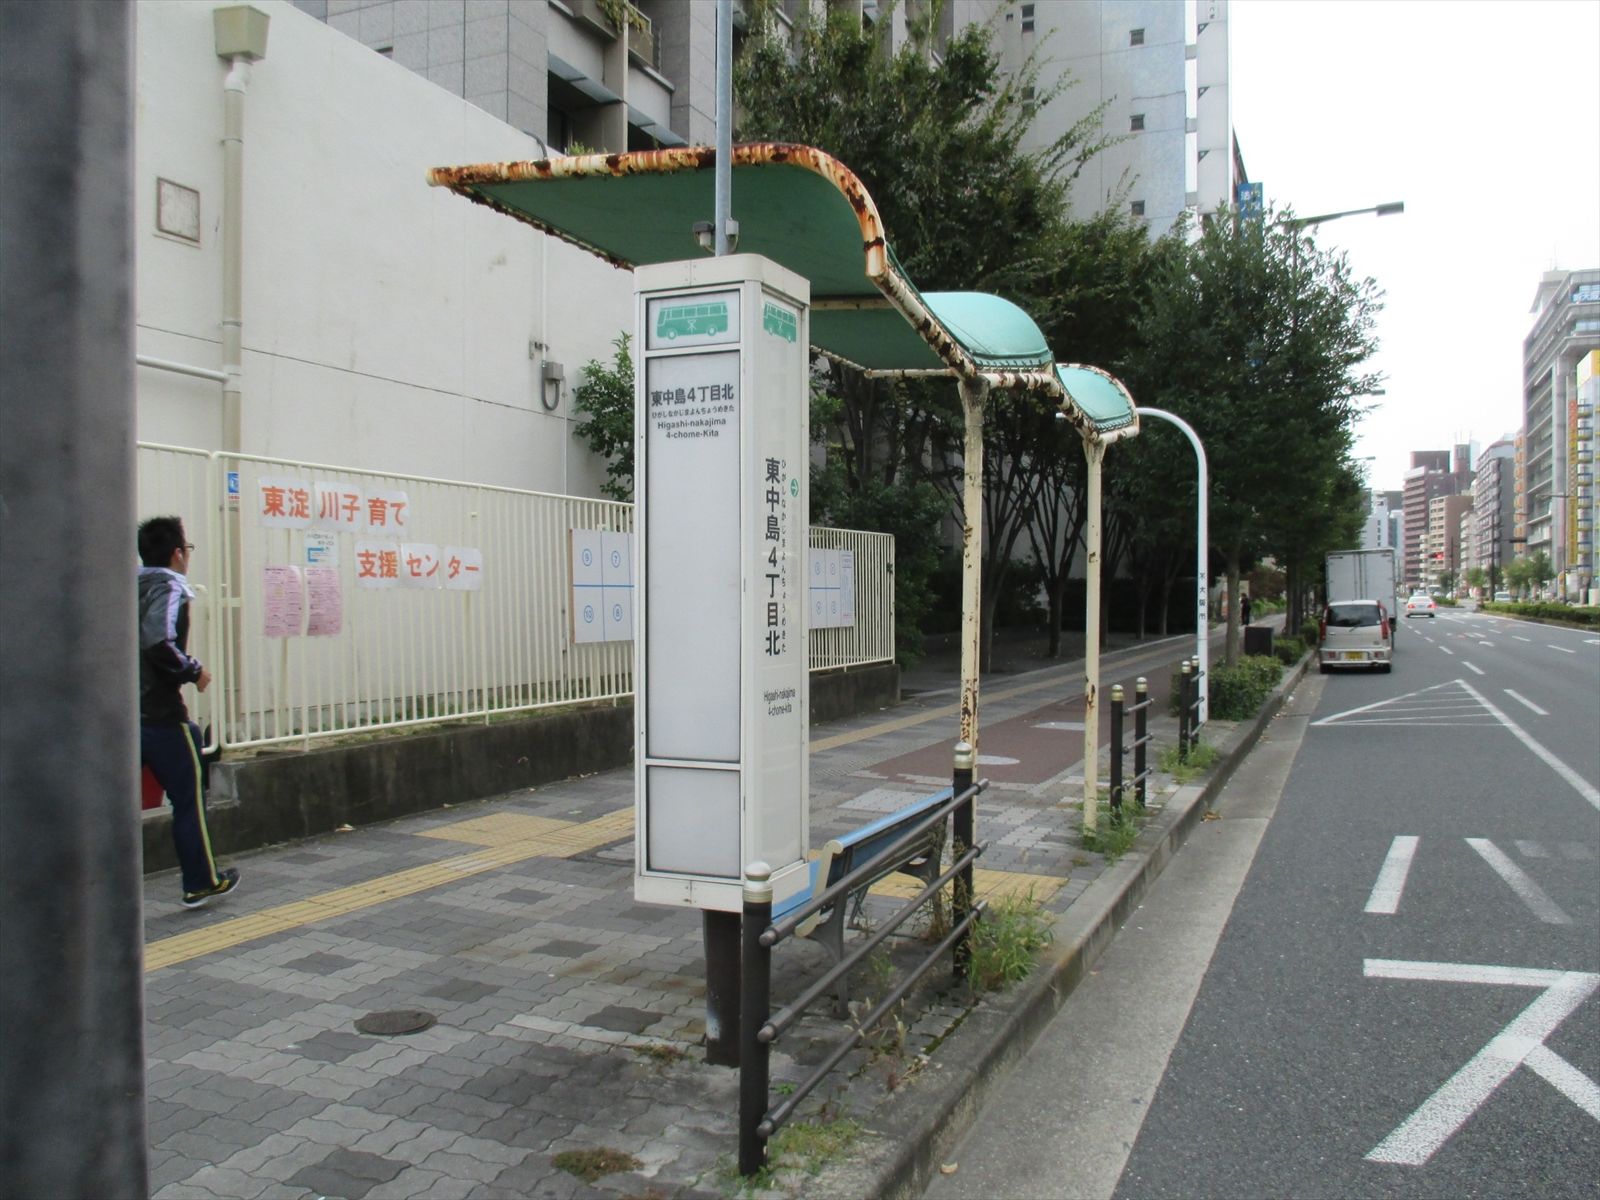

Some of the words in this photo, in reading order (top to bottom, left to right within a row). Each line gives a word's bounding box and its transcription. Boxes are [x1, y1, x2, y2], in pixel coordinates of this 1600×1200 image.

[651, 384, 734, 406] 東中島4丁目北
[657, 418, 727, 430] Higashi-nakajima
[665, 430, 719, 439] 4-chome-Kita
[261, 486, 407, 526] 東淀川子育て
[357, 549, 480, 579] 支援センター
[765, 457, 781, 656] 東中島4丁目北
